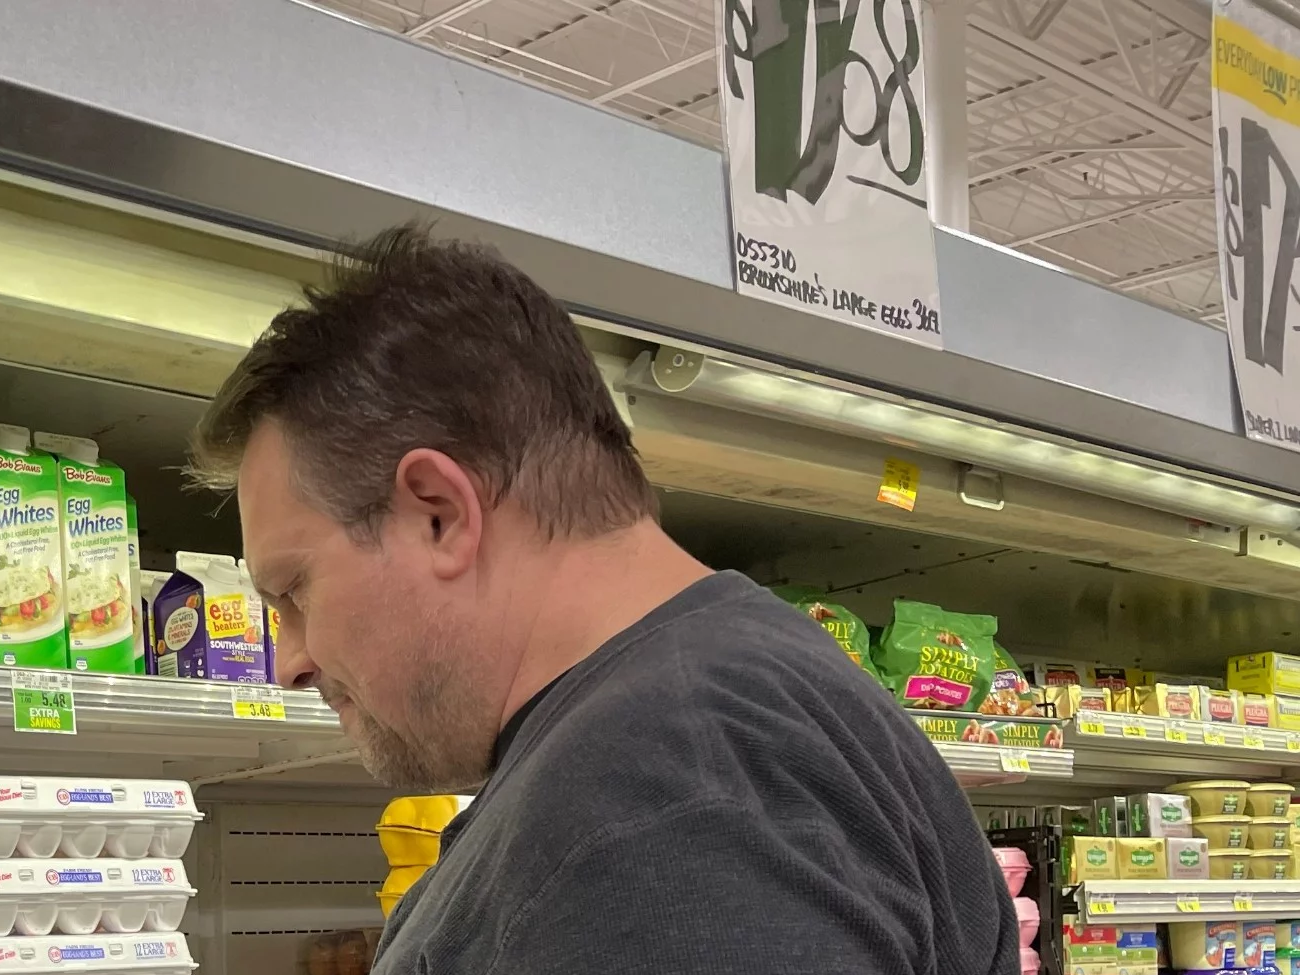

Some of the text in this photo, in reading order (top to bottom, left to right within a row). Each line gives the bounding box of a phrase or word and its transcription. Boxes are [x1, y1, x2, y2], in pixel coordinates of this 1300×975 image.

[832, 289, 877, 320] LARGE
[14, 459, 41, 473] Evans
[64, 468, 111, 484] Bob Evans
[210, 600, 243, 621] egg
[213, 621, 245, 632] beaters
[210, 641, 264, 652] SOUTHWESTERN
[921, 646, 979, 671] SIMPLY
[42, 691, 65, 708] 5.48
[29, 708, 59, 718] EXTRA
[249, 704, 271, 717] 3.48
[30, 717, 61, 728] SAVINGS
[1003, 724, 1040, 738] SIMPLY
[152, 791, 174, 799] EXTRA
[140, 869, 162, 877] EXTRA
